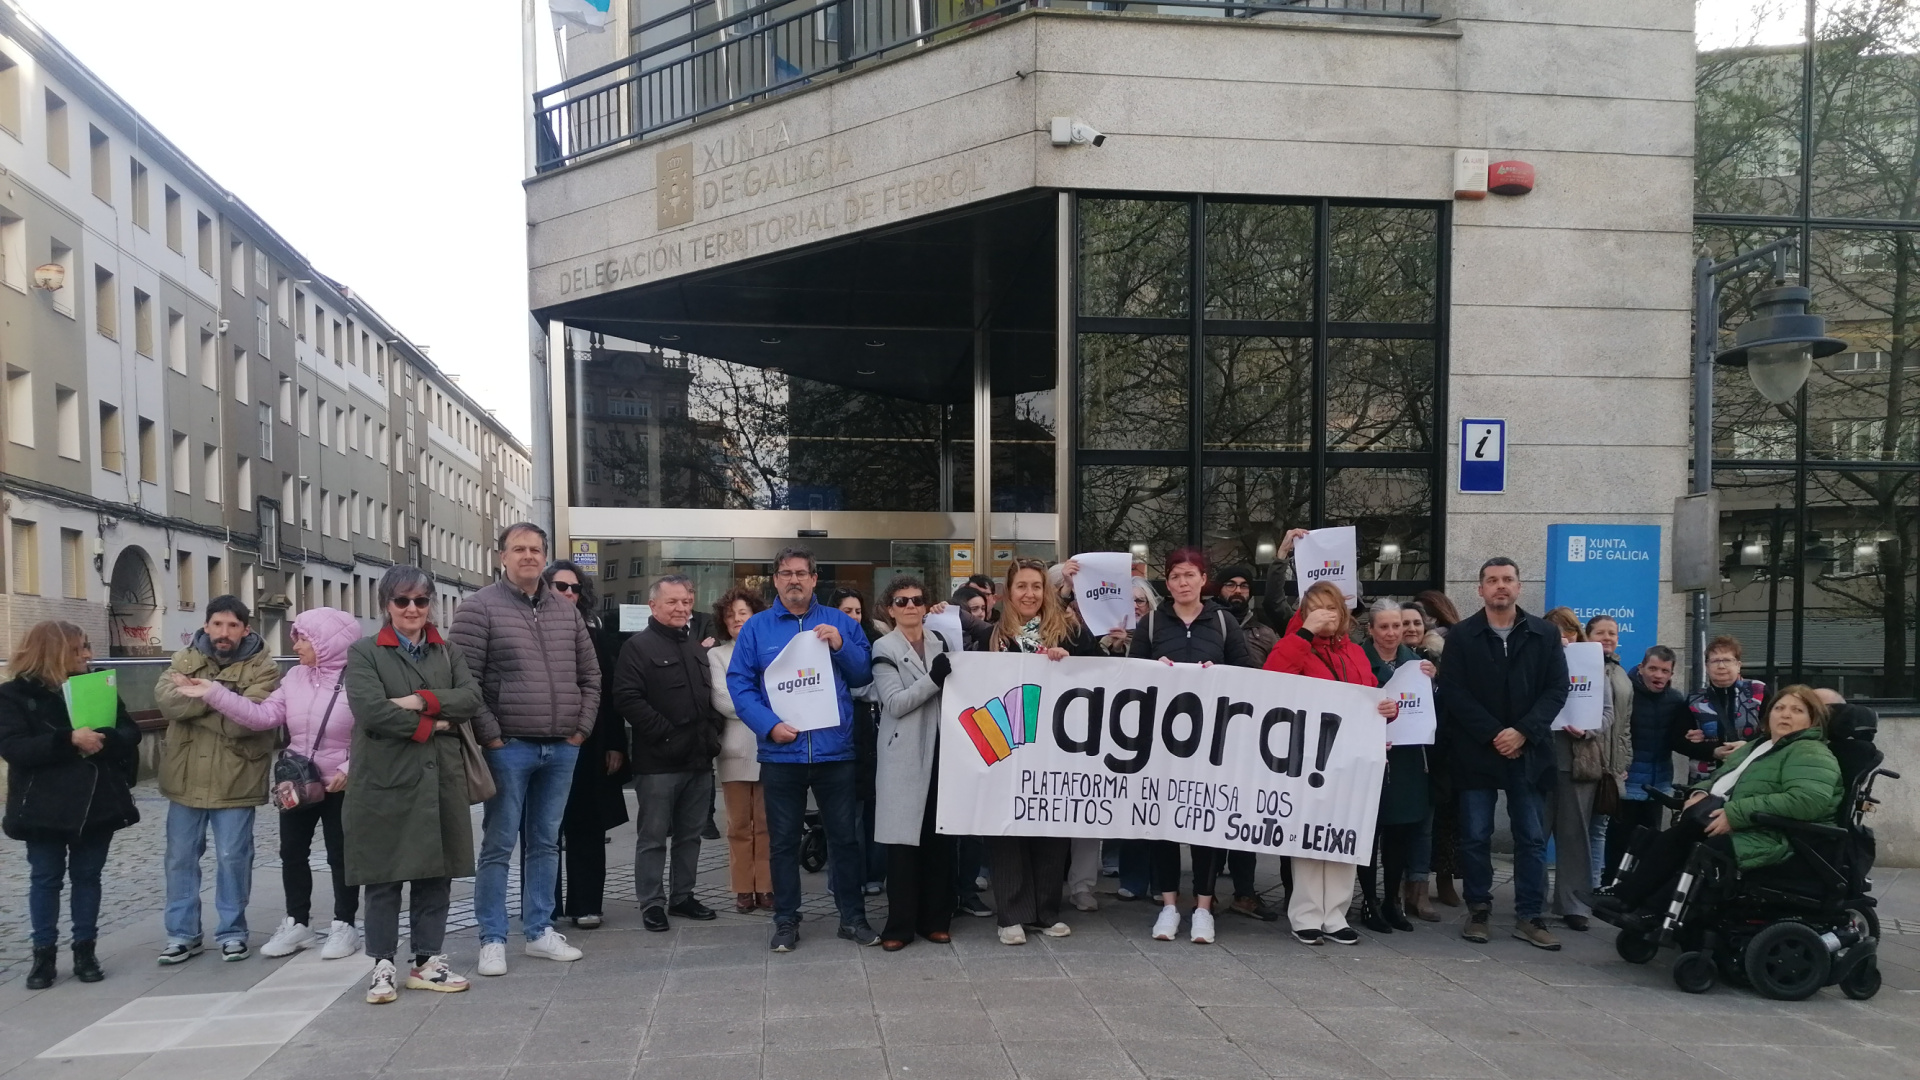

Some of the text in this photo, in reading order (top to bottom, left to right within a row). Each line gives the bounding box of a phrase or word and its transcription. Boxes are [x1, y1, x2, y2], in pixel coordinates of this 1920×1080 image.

[703, 118, 792, 173] XUNTA
[702, 142, 854, 210] DE GALICIA
[559, 163, 987, 296] DELEGACIÓN TERRITORIAL DE FERROL
[1589, 538, 1628, 549] XUNTA
[1588, 549, 1650, 561] DE GALICIA
[1307, 565, 1345, 581] agora!
[1086, 586, 1121, 601] agora!
[1573, 605, 1635, 618] ELEGACIÓN
[777, 673, 821, 694] agora!
[1568, 680, 1592, 692] ora!
[1397, 697, 1421, 709] ora!
[1051, 685, 1342, 788] agora!
[1021, 769, 1293, 818] PLATAFORMA EN DEFENSA DOS
[1131, 802, 1161, 826] NO
